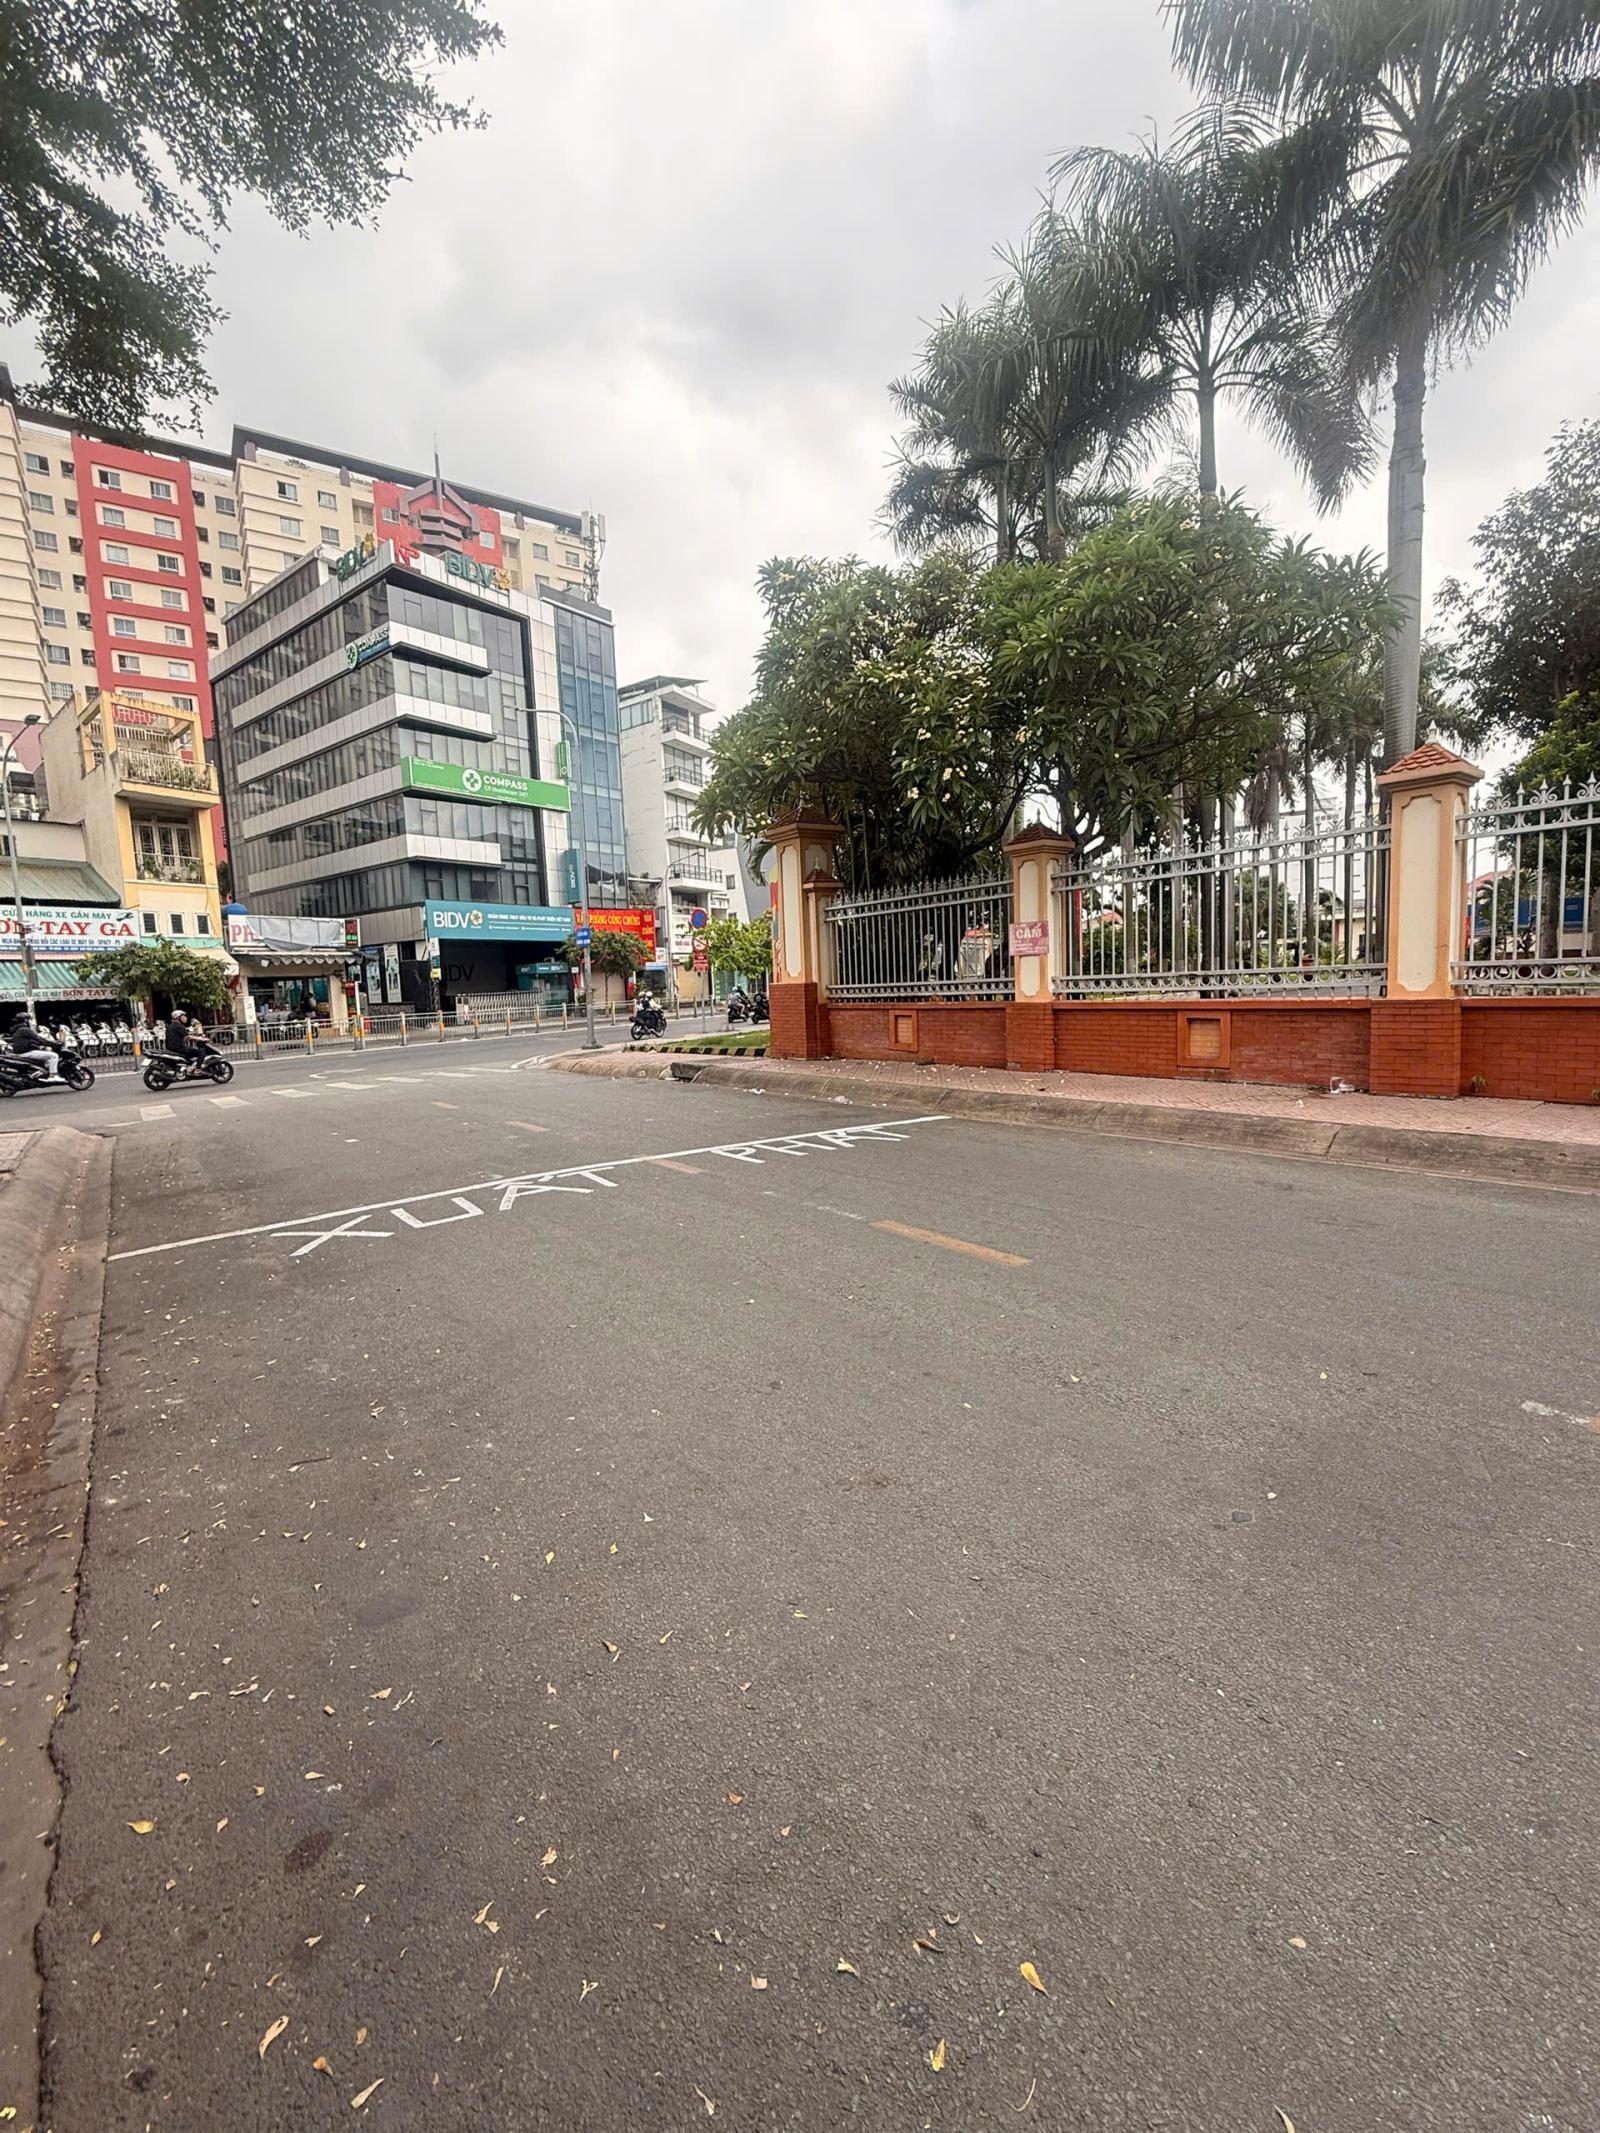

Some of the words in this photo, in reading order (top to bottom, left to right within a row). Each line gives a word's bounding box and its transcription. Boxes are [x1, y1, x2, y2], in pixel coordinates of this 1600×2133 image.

[447, 550, 496, 588] BIDV
[483, 775, 528, 791] COMPASS
[0, 918, 30, 935] ƠN
[40, 921, 91, 936] TAY
[99, 922, 134, 937] GA
[433, 910, 470, 929] BIDV
[86, 988, 107, 997] TAY
[268, 1166, 619, 1256] XUẤT
[709, 1122, 911, 1163] PHÁT
